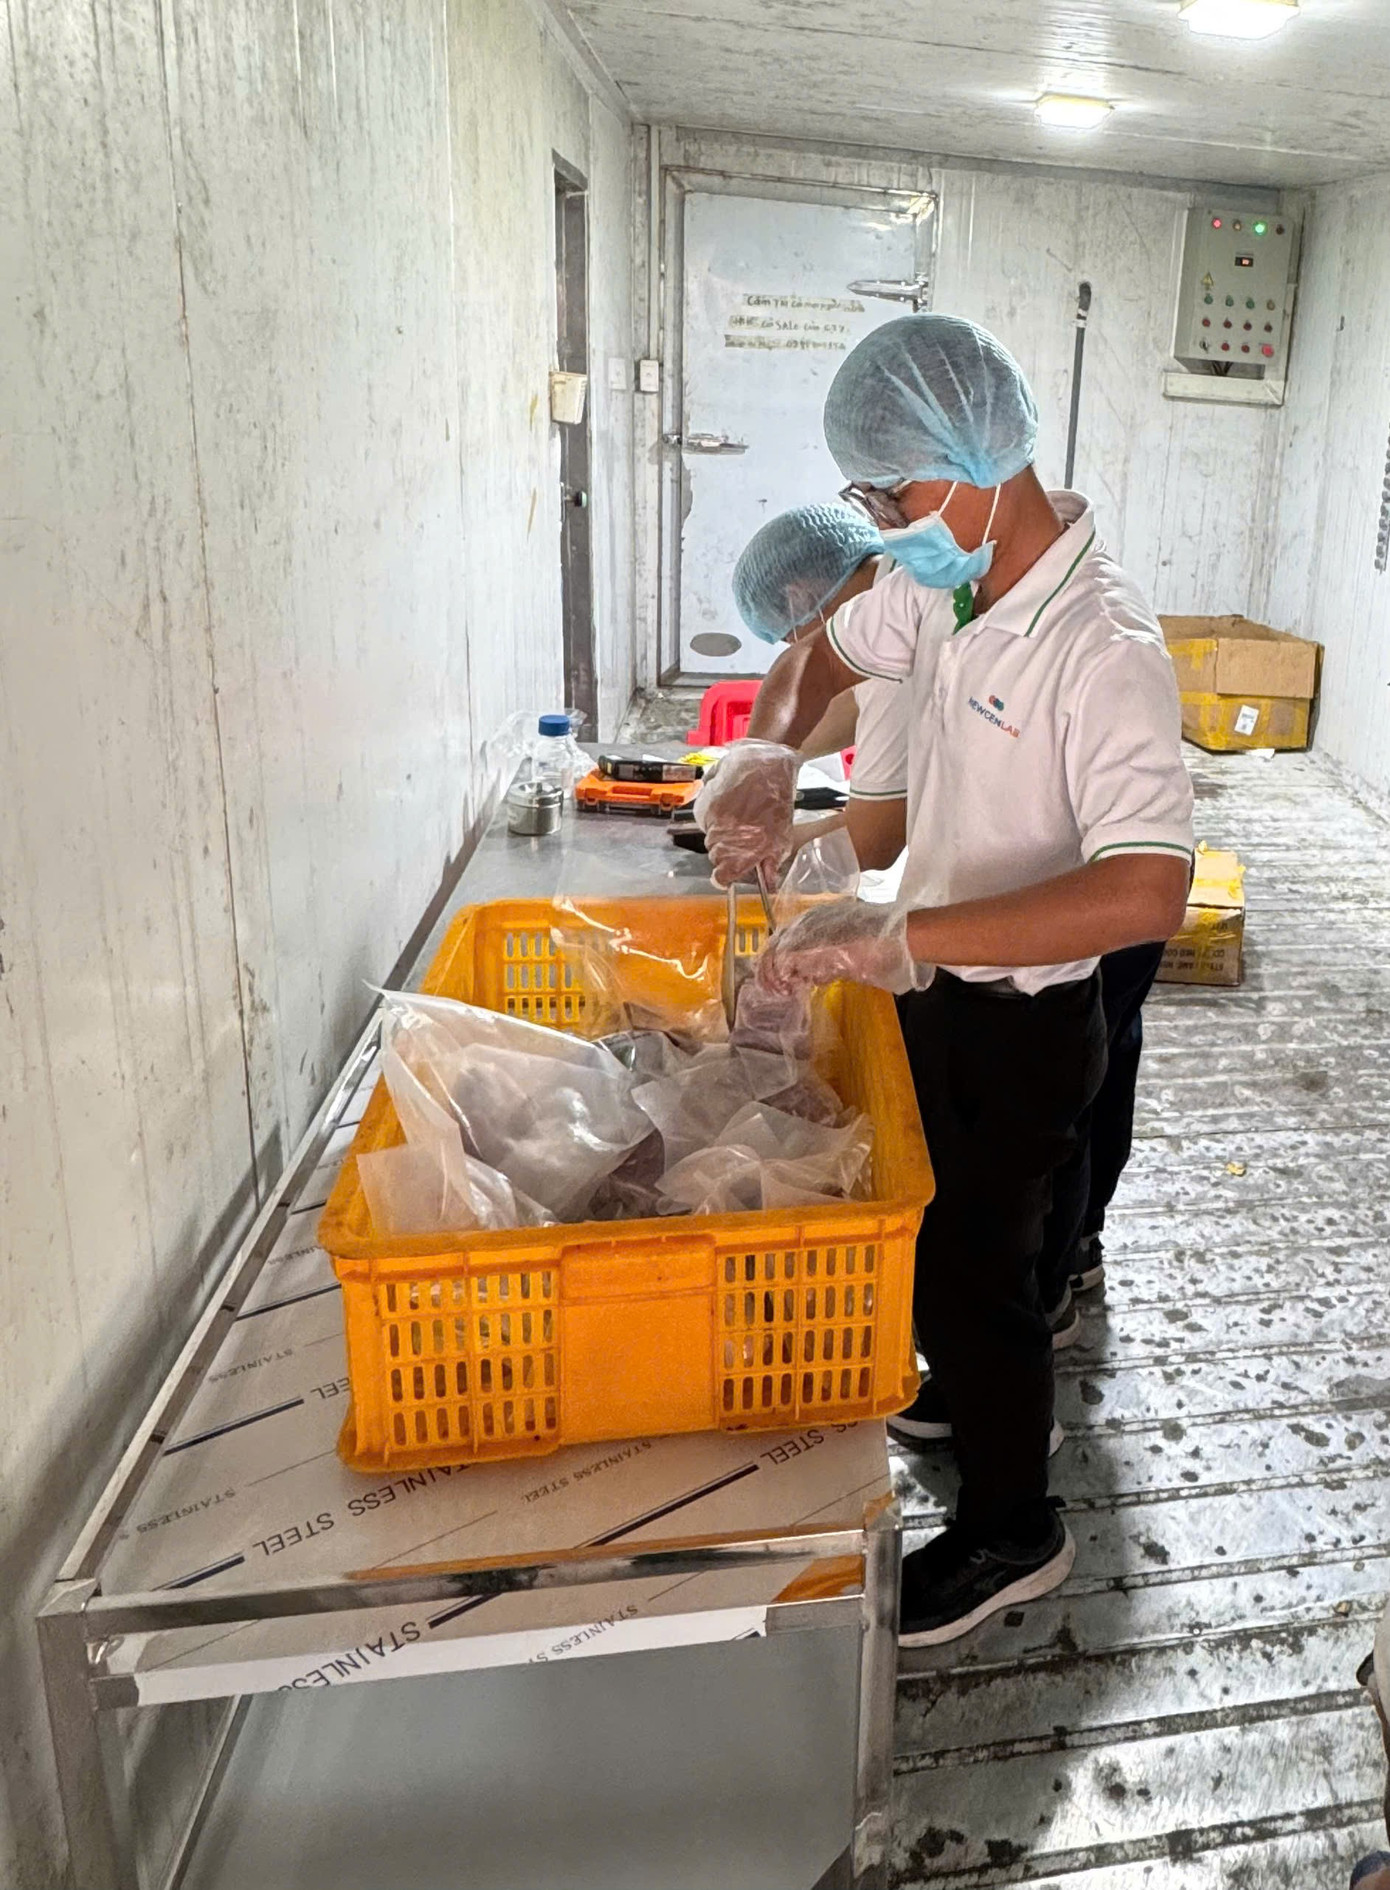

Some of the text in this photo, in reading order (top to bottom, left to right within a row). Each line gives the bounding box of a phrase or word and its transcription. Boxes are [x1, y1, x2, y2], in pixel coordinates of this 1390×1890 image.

[310, 1376, 351, 1399] EEL
[760, 1429, 825, 1465] STEEL
[522, 1441, 651, 1503] STAINLESS STEEL
[136, 1488, 236, 1535] STAINLESS
[252, 1512, 335, 1556] STEEL
[552, 1604, 638, 1656] STAINLESS
